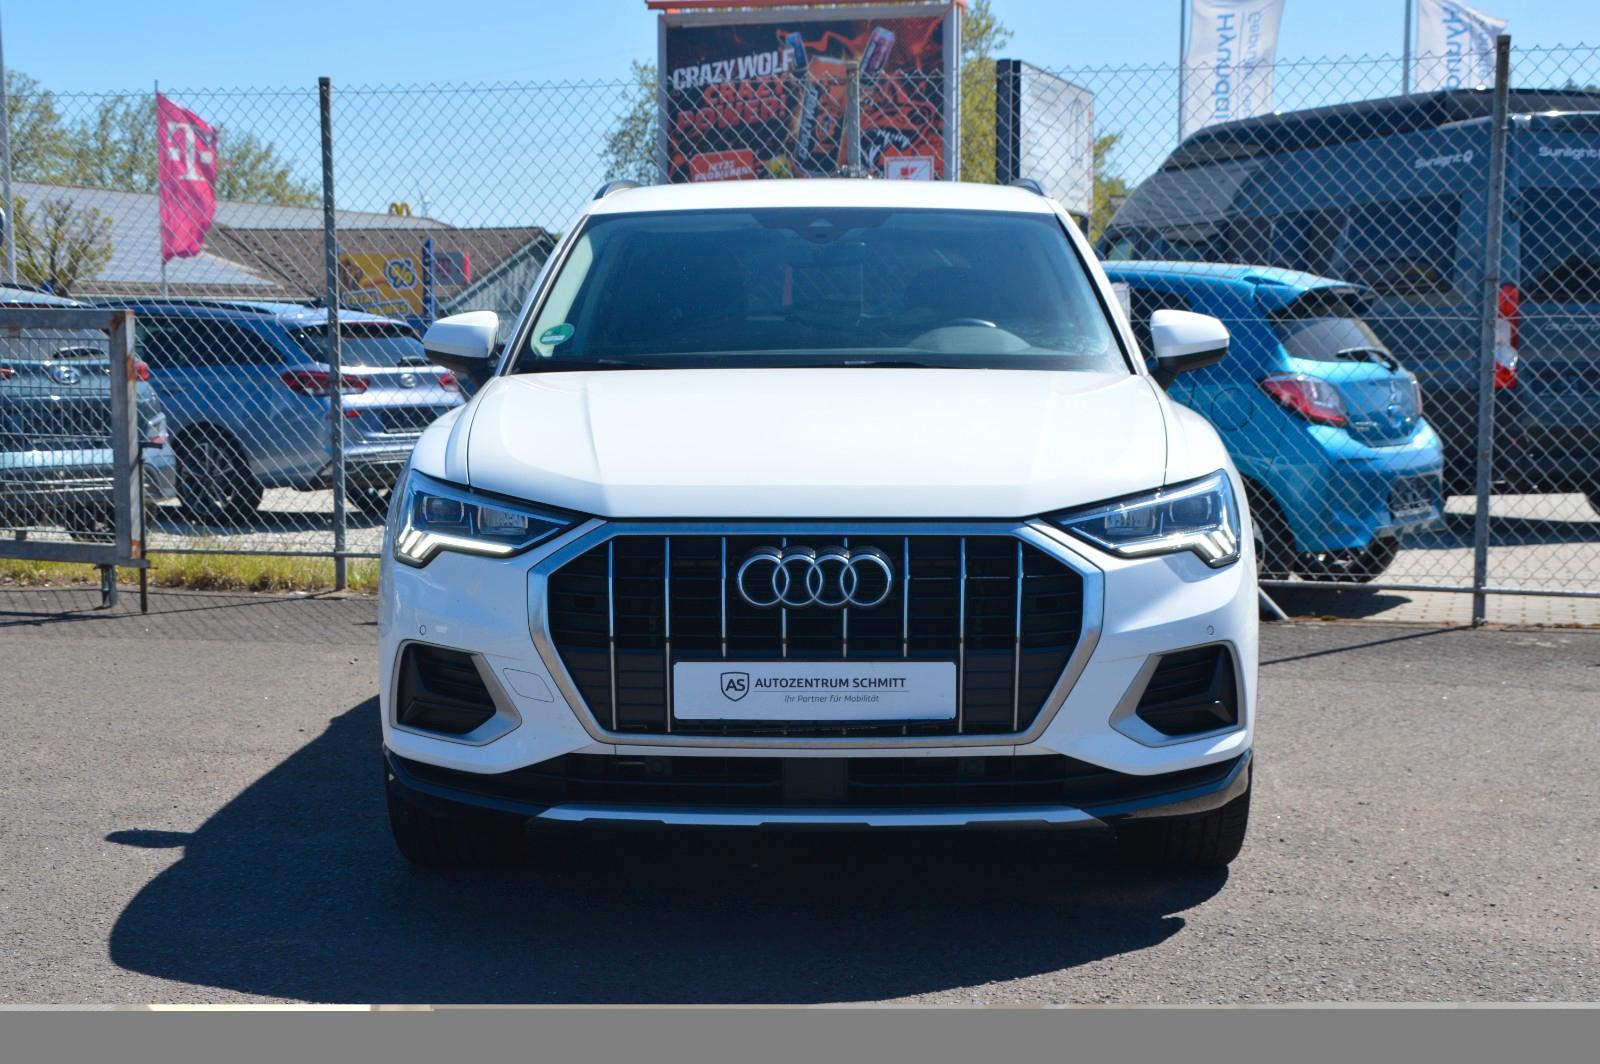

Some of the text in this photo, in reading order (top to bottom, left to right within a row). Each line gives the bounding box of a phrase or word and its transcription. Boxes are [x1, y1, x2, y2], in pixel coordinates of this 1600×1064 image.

[673, 60, 736, 91] CRAZY
[737, 48, 795, 80] WOLF
[725, 679, 746, 692] AS
[754, 677, 907, 688] AUTOZENTRUM SCHMITT
[784, 694, 880, 704] Ihr Partner für Mobilität
